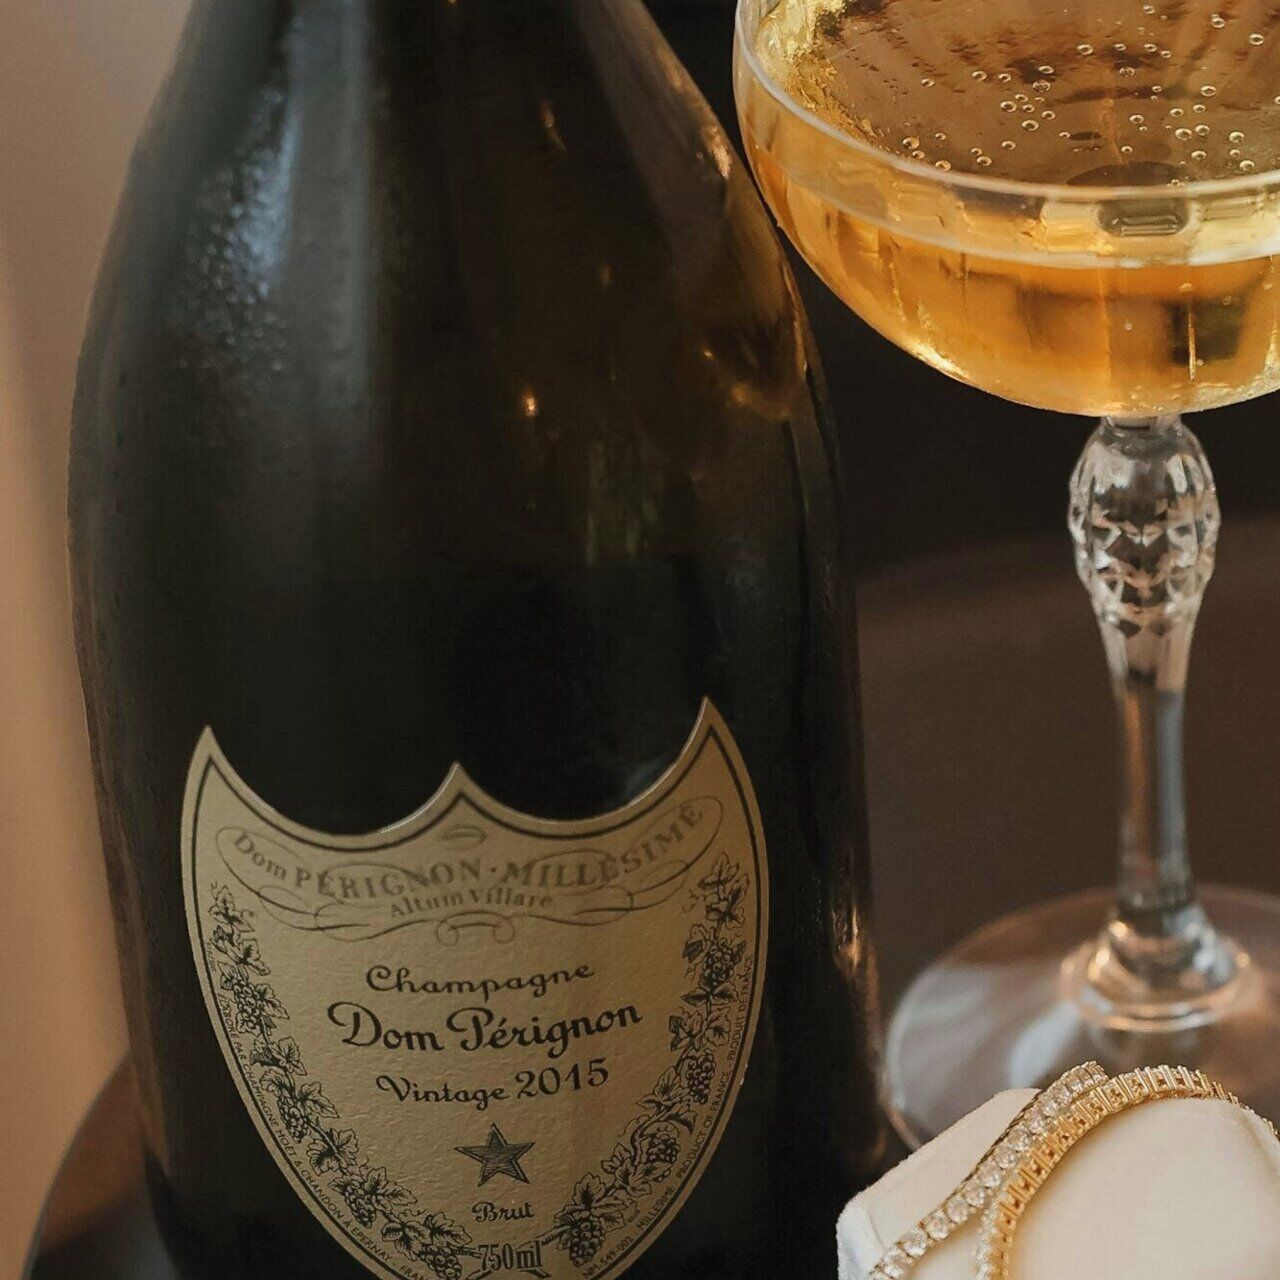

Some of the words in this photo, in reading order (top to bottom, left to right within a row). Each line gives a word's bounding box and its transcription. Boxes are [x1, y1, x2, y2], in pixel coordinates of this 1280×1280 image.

[233, 832, 289, 881] Dom
[366, 965, 595, 1002] Champagne
[327, 1001, 445, 1051] Dom
[446, 1004, 643, 1059] Pérignon
[376, 1076, 509, 1111] Vintage
[515, 1058, 609, 1098] 2015
[243, 1063, 280, 1127] CHAMPAGNE
[301, 1170, 345, 1220] CHANDON
[472, 1201, 535, 1223] Brut
